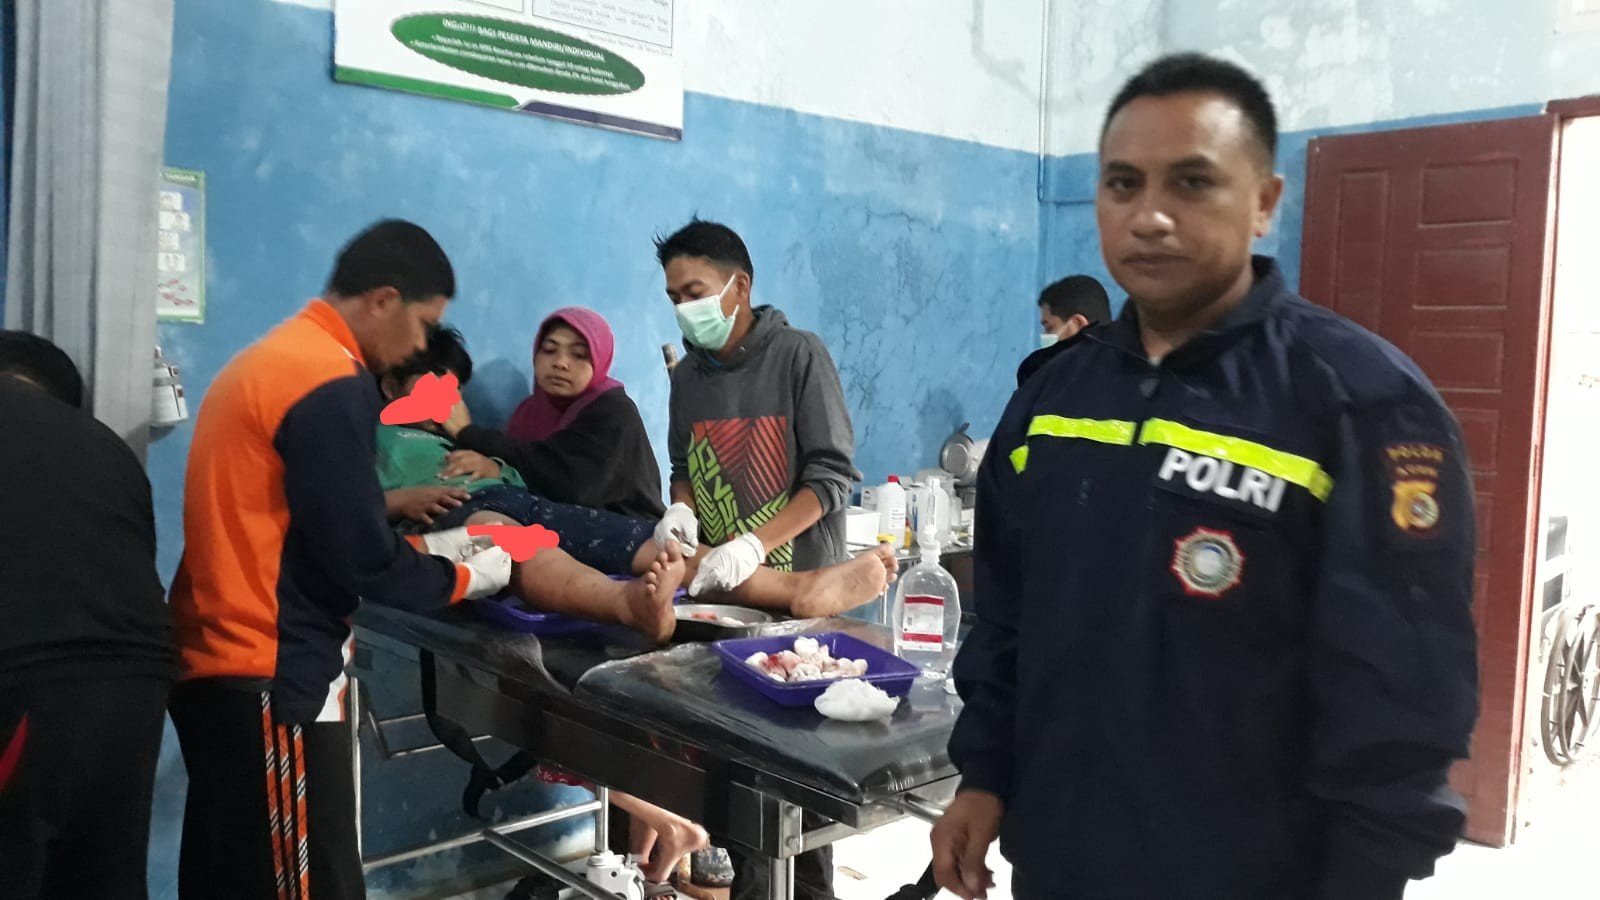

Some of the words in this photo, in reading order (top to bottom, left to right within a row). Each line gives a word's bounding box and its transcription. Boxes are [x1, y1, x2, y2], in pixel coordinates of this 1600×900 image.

[477, 25, 497, 38] BAGI
[497, 28, 529, 45] PESERTA
[530, 36, 605, 62] MANDIRI/INDIVIDUAL
[1158, 448, 1286, 513] POLRI
